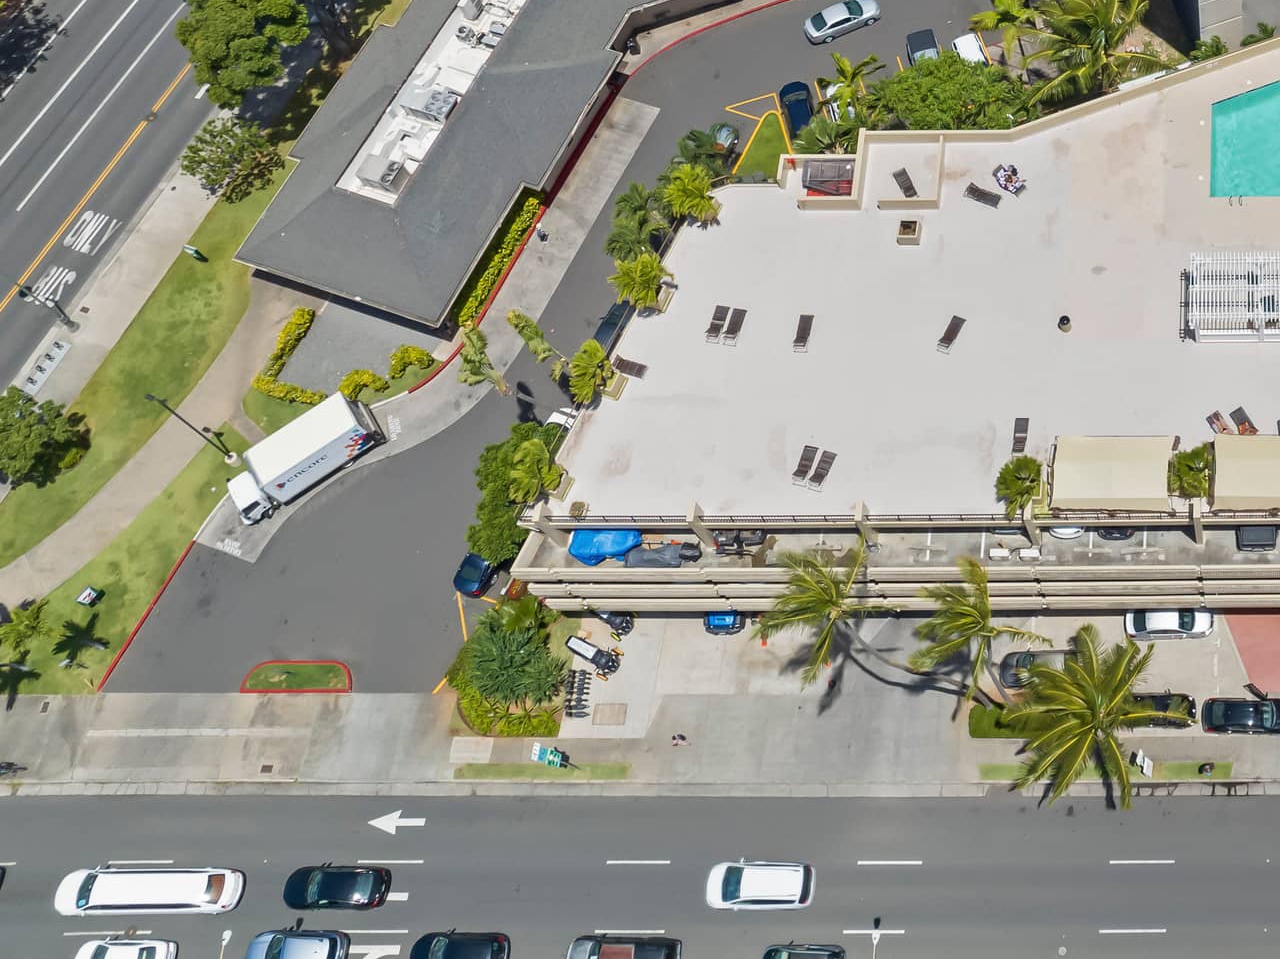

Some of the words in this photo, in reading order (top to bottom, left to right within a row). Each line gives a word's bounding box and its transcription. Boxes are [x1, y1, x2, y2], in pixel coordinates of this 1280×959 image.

[63, 210, 122, 256] ONLY
[23, 265, 76, 307] BUS
[287, 454, 328, 482] encore
